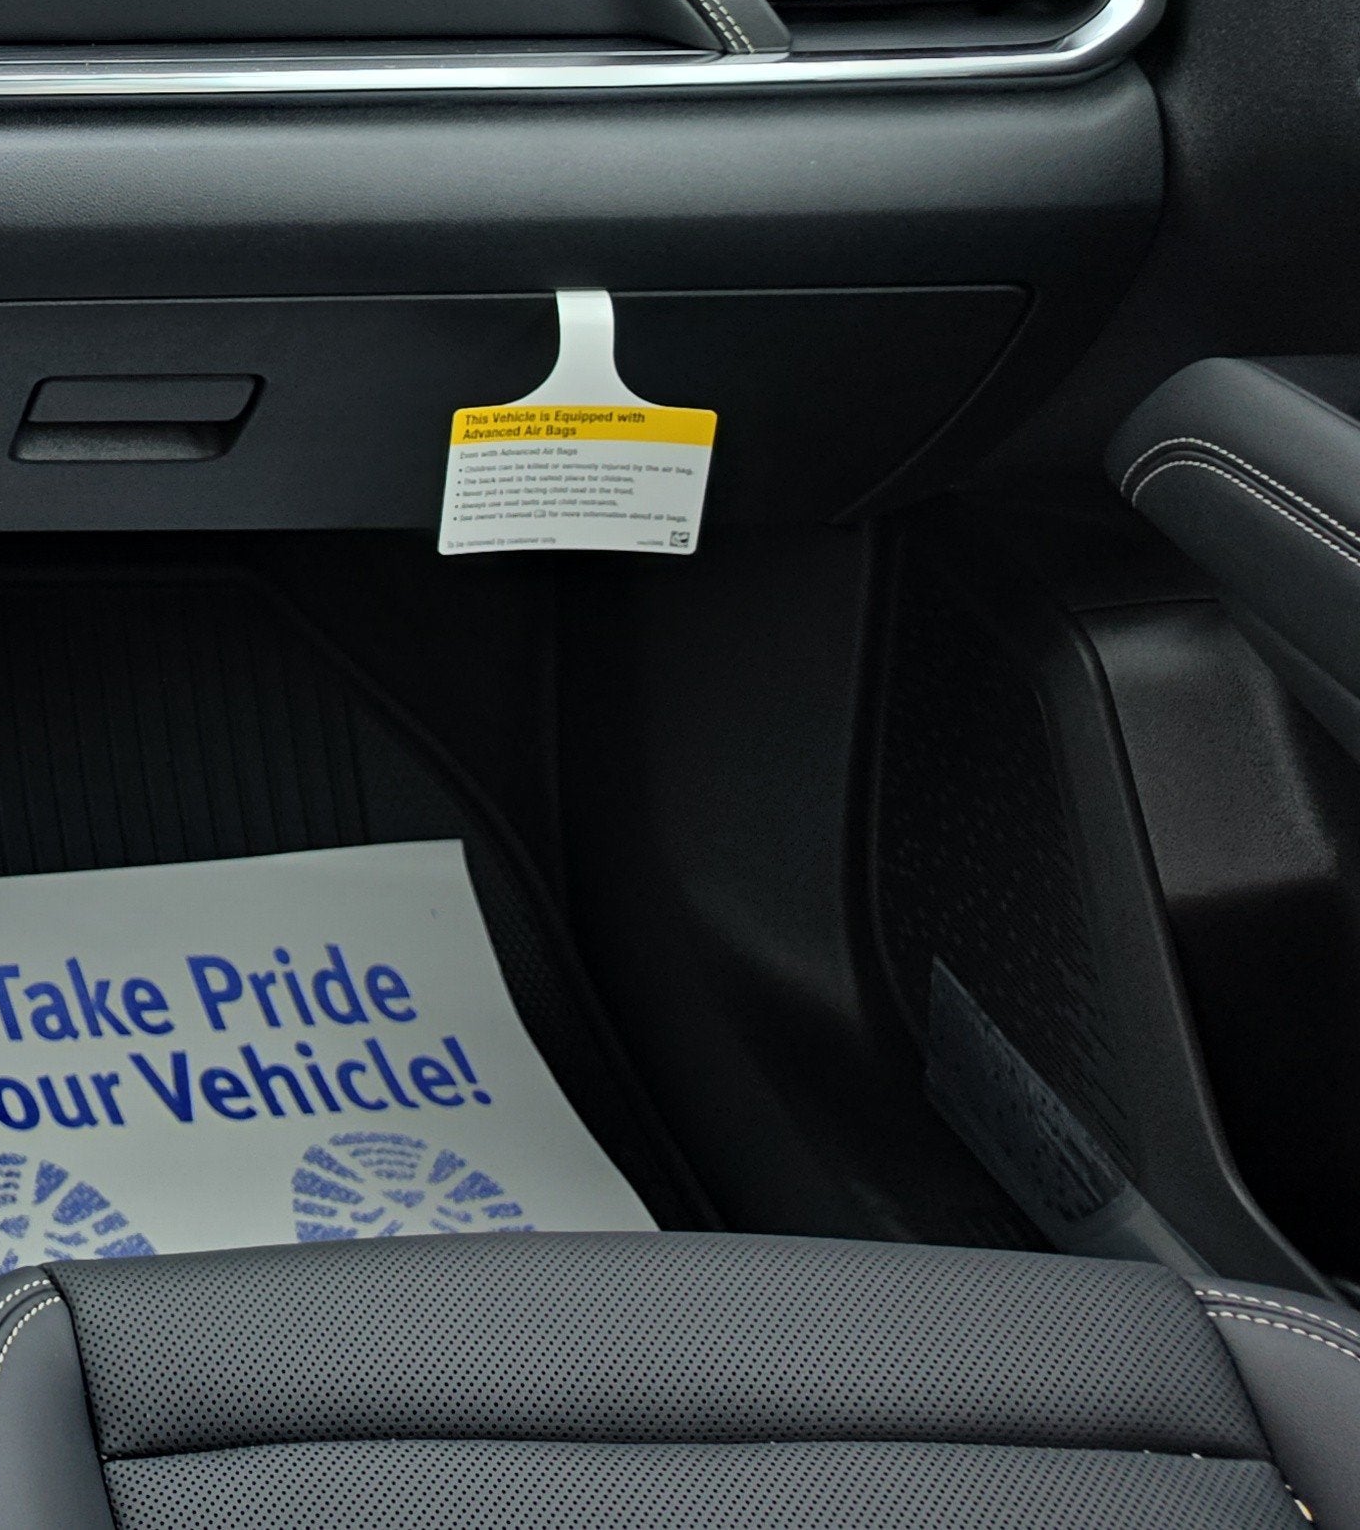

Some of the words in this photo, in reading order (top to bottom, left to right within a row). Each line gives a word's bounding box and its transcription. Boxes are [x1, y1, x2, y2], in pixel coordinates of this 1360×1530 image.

[463, 427, 521, 440] Advanced
[525, 425, 542, 437] Air
[545, 425, 577, 438] Bags
[464, 415, 489, 425] This
[493, 412, 536, 423] Vehicle
[540, 412, 550, 422] is
[554, 409, 613, 424] Equipped
[617, 412, 646, 423] with
[188, 944, 418, 1032] Pride
[130, 1036, 492, 1125] Vehicle!
